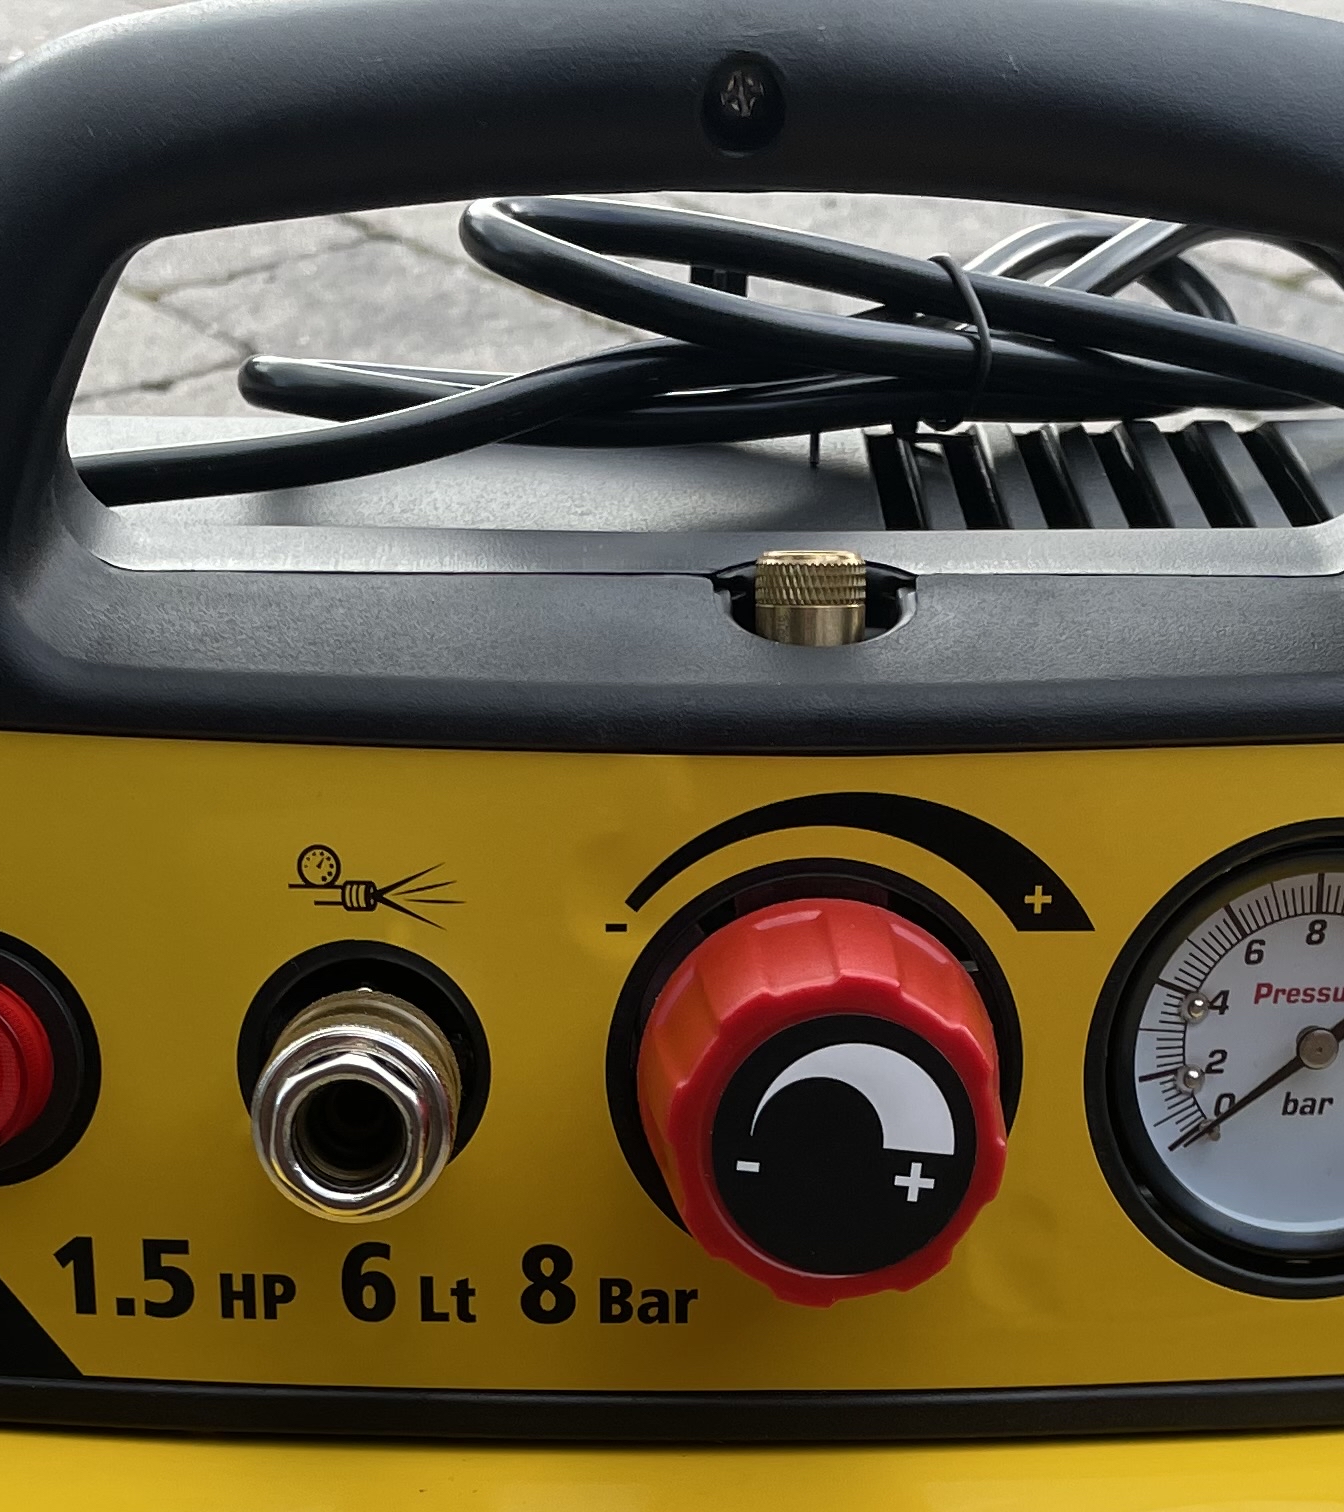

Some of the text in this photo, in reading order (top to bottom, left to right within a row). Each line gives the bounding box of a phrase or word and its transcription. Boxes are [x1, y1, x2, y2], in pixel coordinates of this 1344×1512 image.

[1305, 919, 1327, 946] 8
[1243, 939, 1266, 965] 6
[1208, 989, 1230, 1016] 4
[1205, 1049, 1228, 1075] 2
[1213, 1092, 1236, 1118] 0
[1281, 1091, 1334, 1117] bar
[52, 1236, 698, 1325] 1.5 HP 6 Lt 8 Bar
